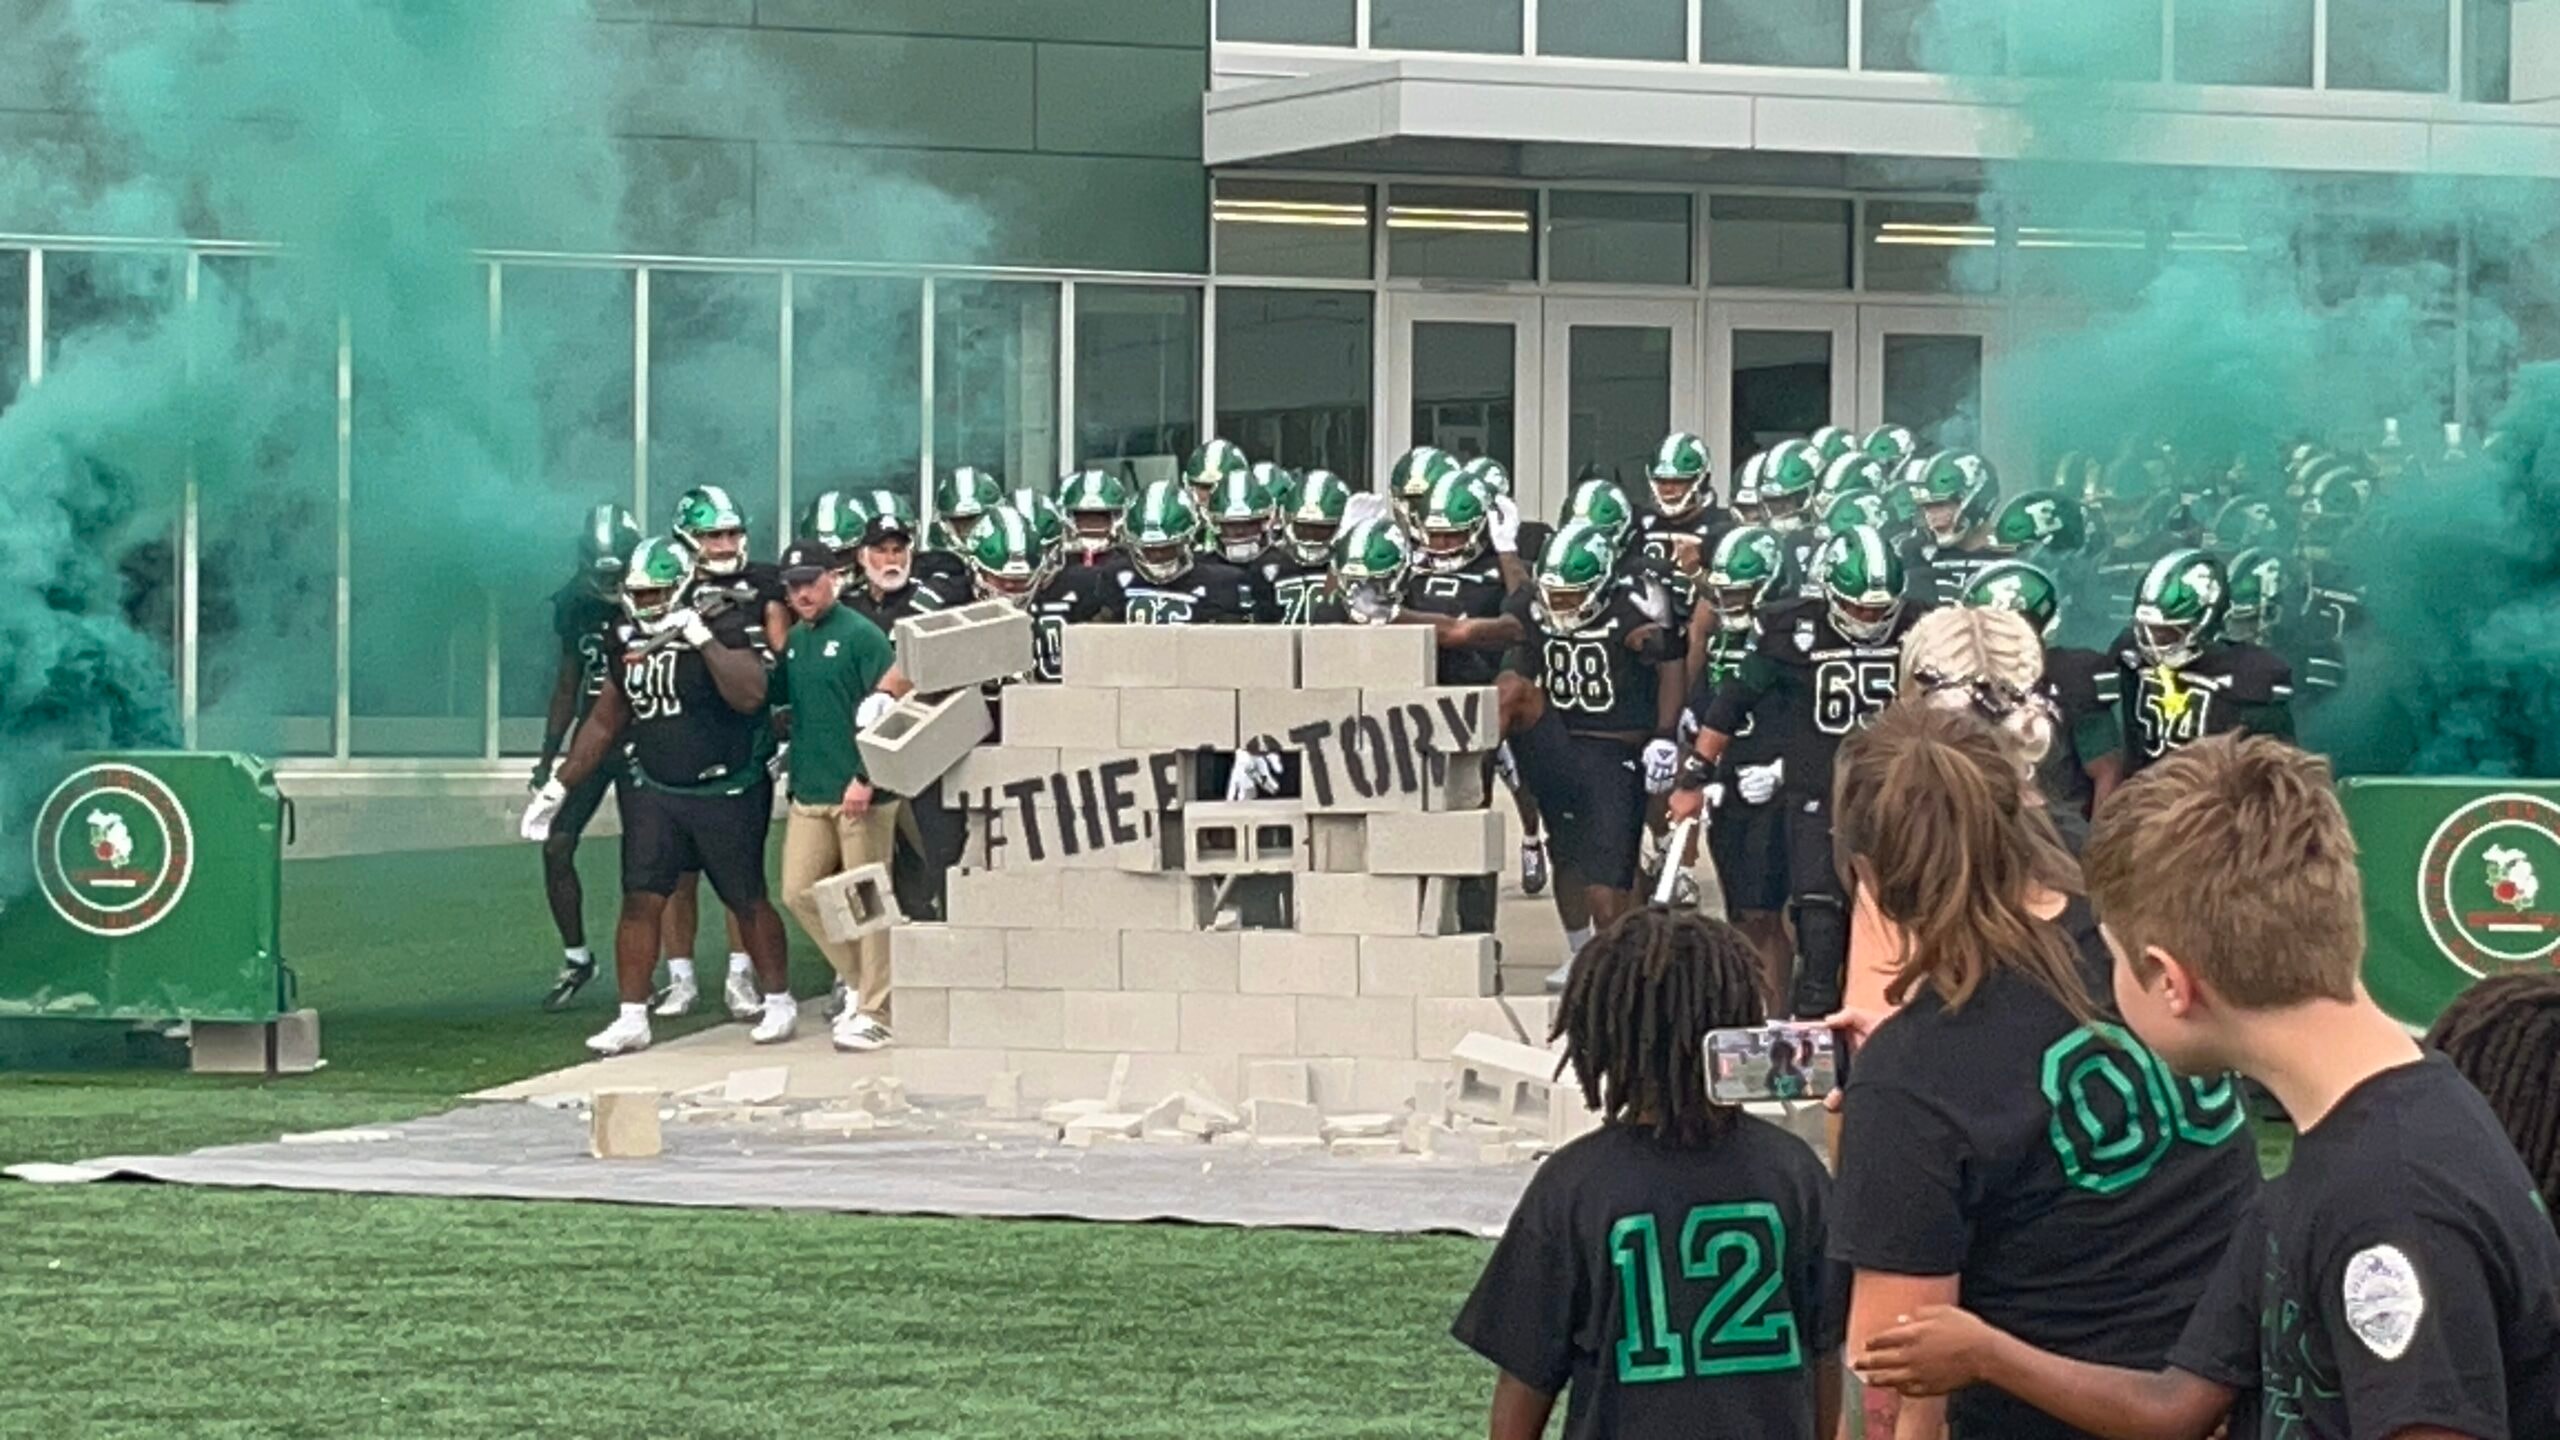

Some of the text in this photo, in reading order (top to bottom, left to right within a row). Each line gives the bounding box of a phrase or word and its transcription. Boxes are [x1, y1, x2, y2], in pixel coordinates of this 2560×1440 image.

[624, 650, 682, 719] 91
[1543, 639, 1614, 713] 88
[1814, 661, 1898, 735] 65
[957, 692, 1479, 876] #THEFTORY
[1610, 1200, 1800, 1383] 12
